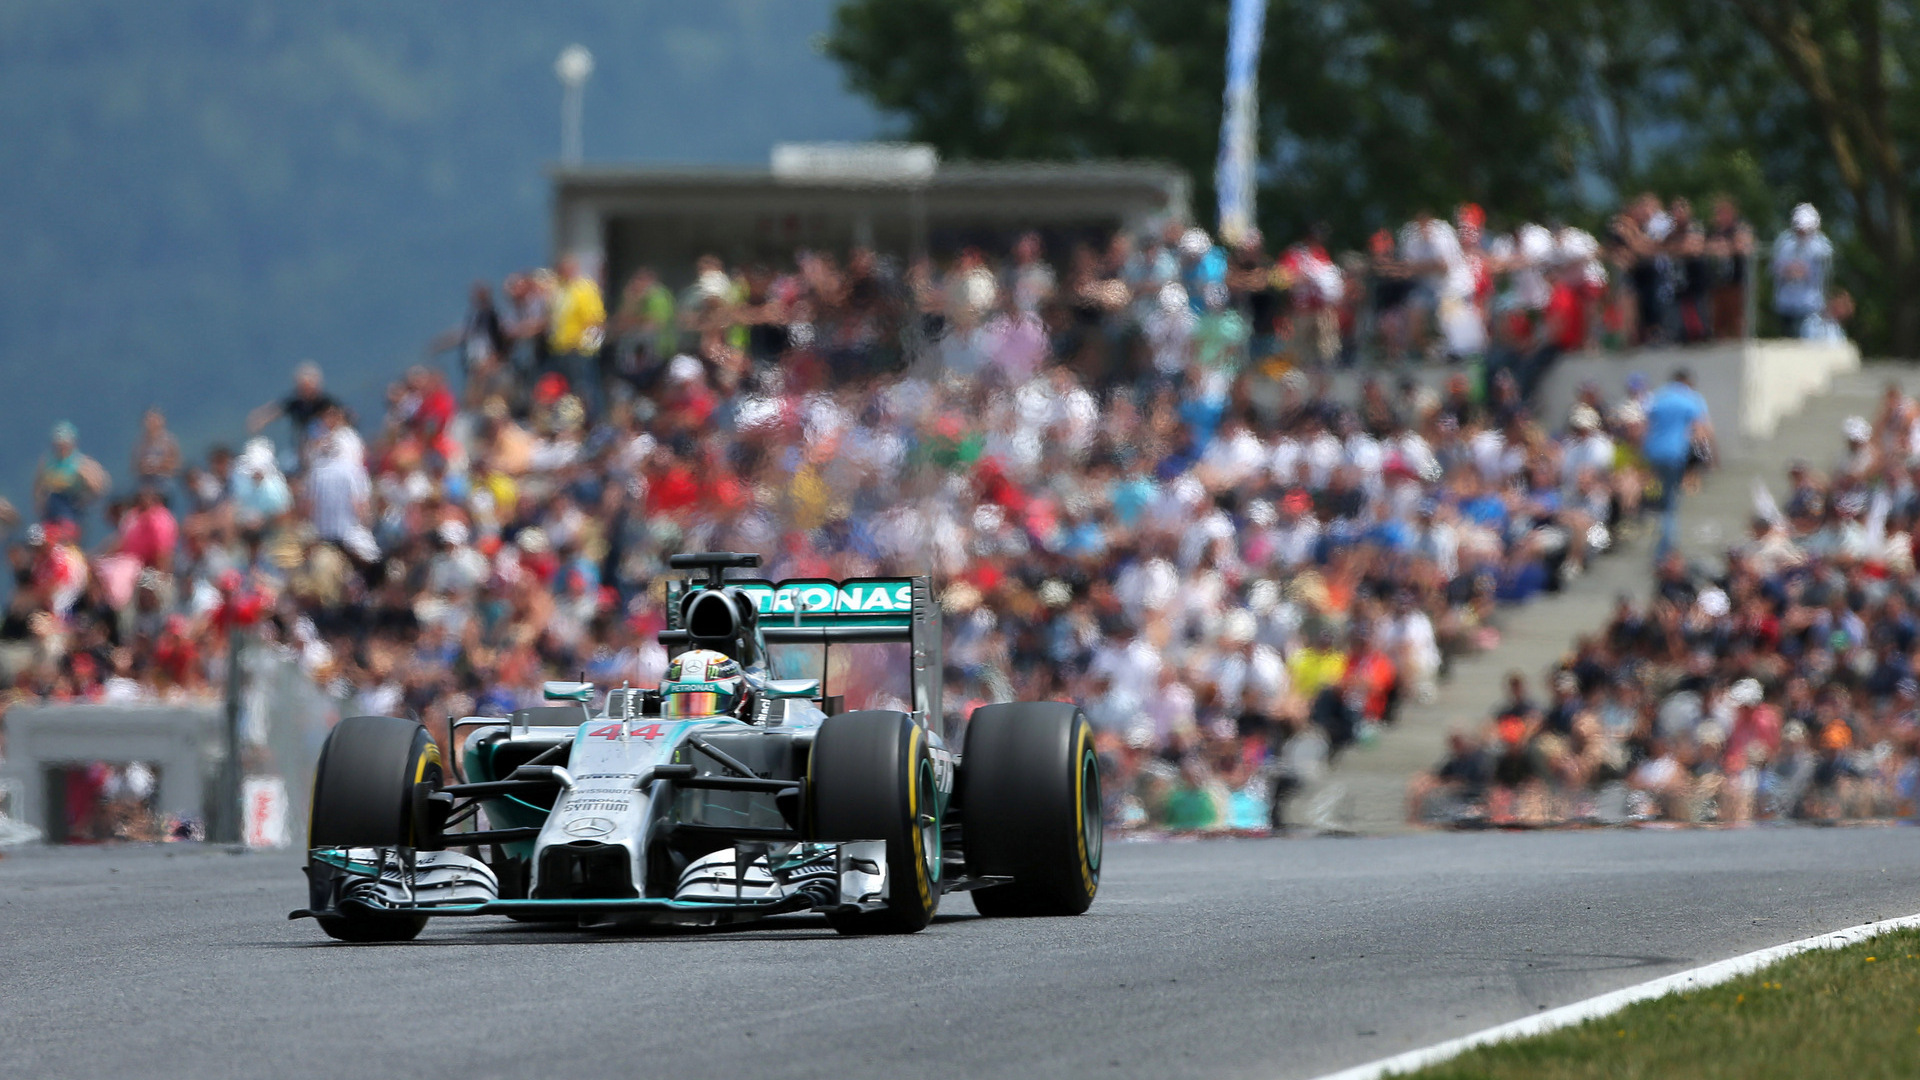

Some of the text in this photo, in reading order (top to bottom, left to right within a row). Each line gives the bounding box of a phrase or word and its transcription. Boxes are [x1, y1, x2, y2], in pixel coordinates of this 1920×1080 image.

[671, 684, 715, 692] PETRONAS
[589, 724, 664, 740] 44
[564, 803, 628, 812] SYNTIUM
